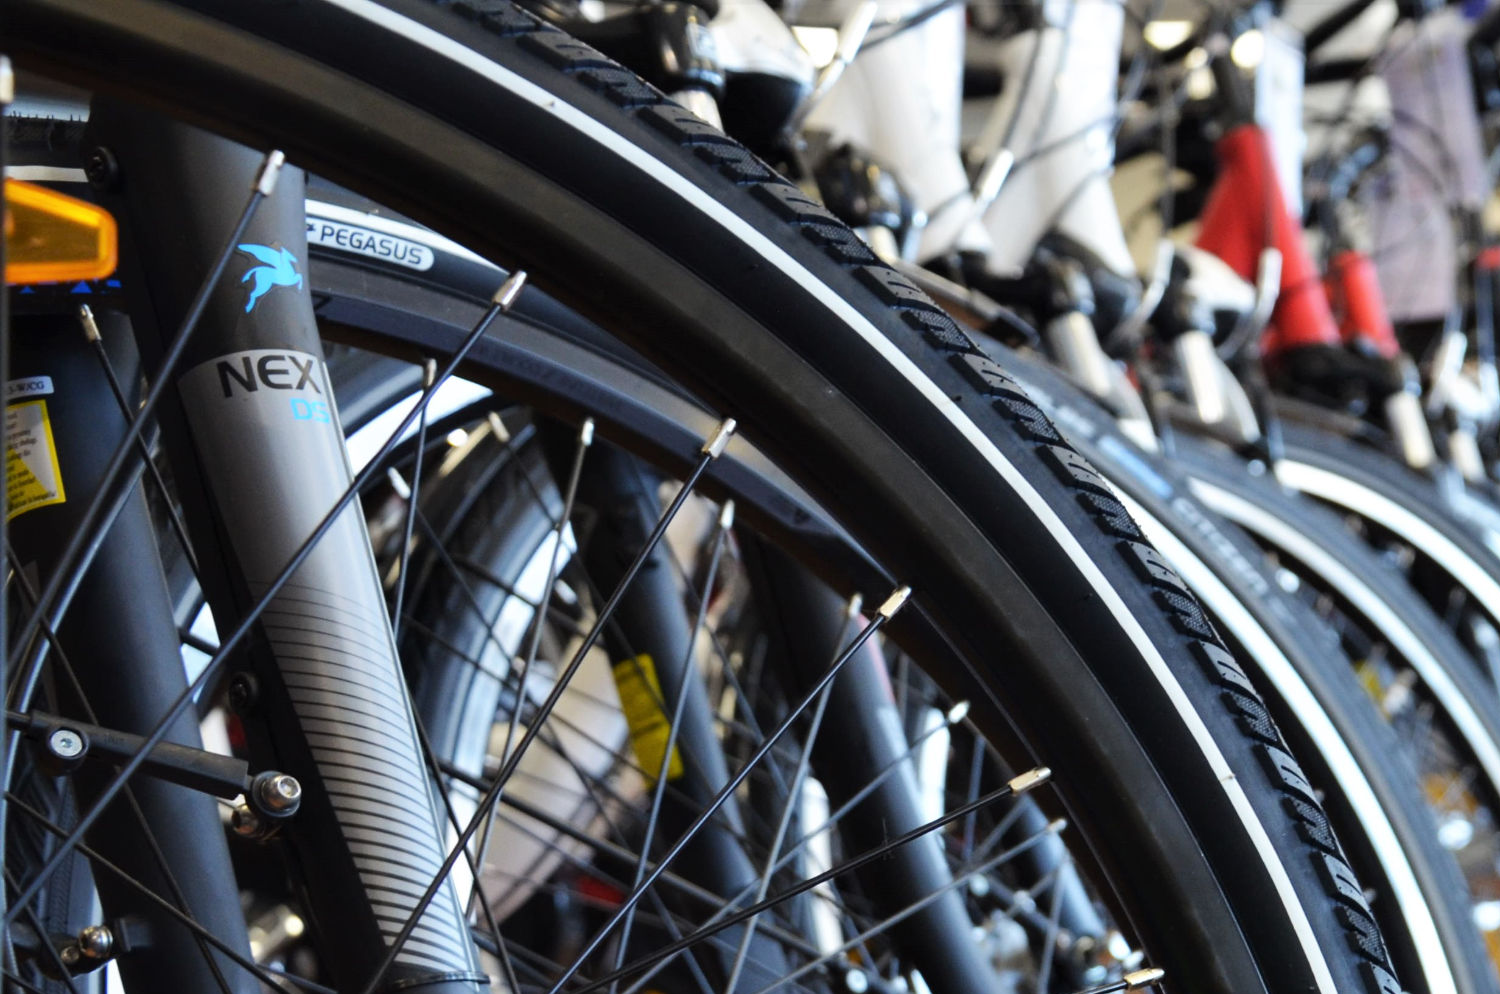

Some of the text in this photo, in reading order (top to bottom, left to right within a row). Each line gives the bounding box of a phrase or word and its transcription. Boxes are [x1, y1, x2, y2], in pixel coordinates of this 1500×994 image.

[319, 224, 423, 265] PEGASUS
[215, 354, 322, 399] NEX
[289, 397, 331, 424] DS
